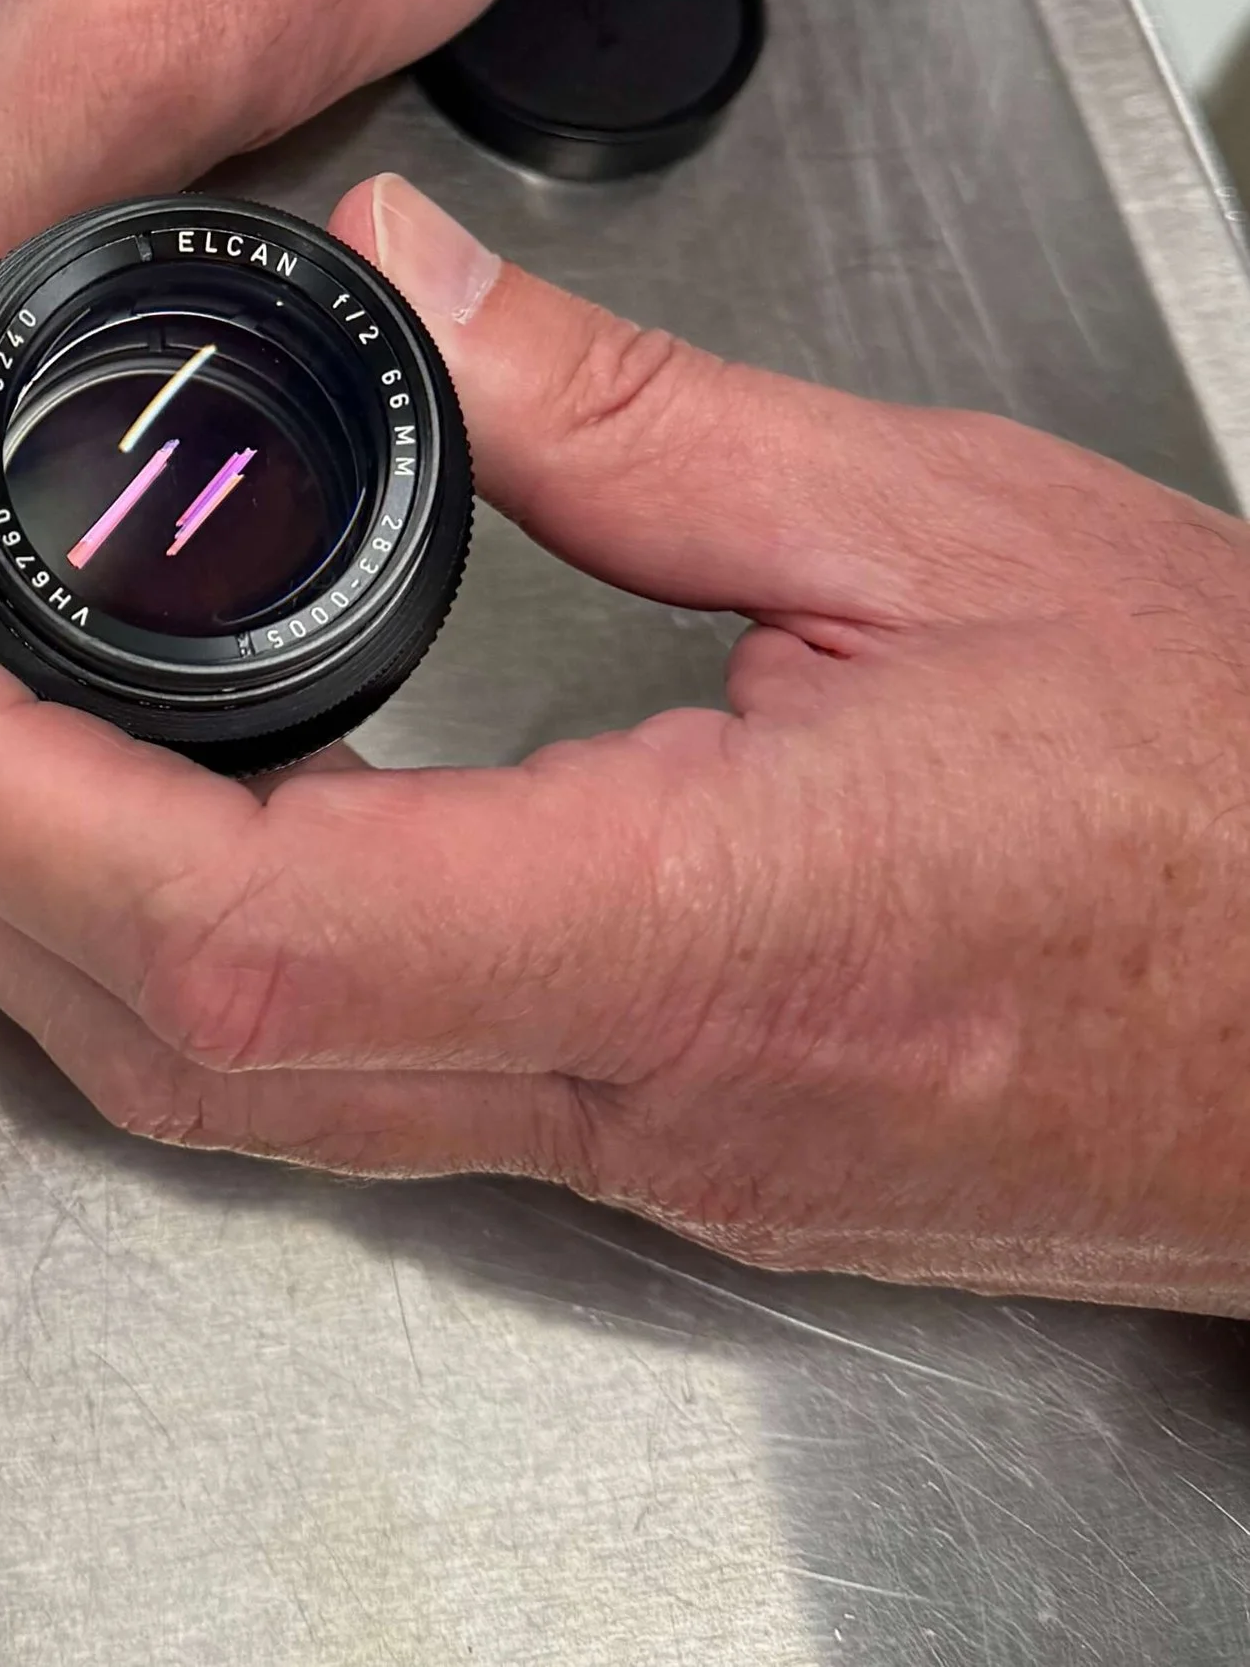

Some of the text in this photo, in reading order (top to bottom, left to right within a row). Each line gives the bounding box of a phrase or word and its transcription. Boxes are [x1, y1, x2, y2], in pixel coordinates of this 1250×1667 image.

[177, 230, 297, 277] ELCAN
[331, 293, 380, 346] f/2
[266, 513, 403, 648] 283-0005
